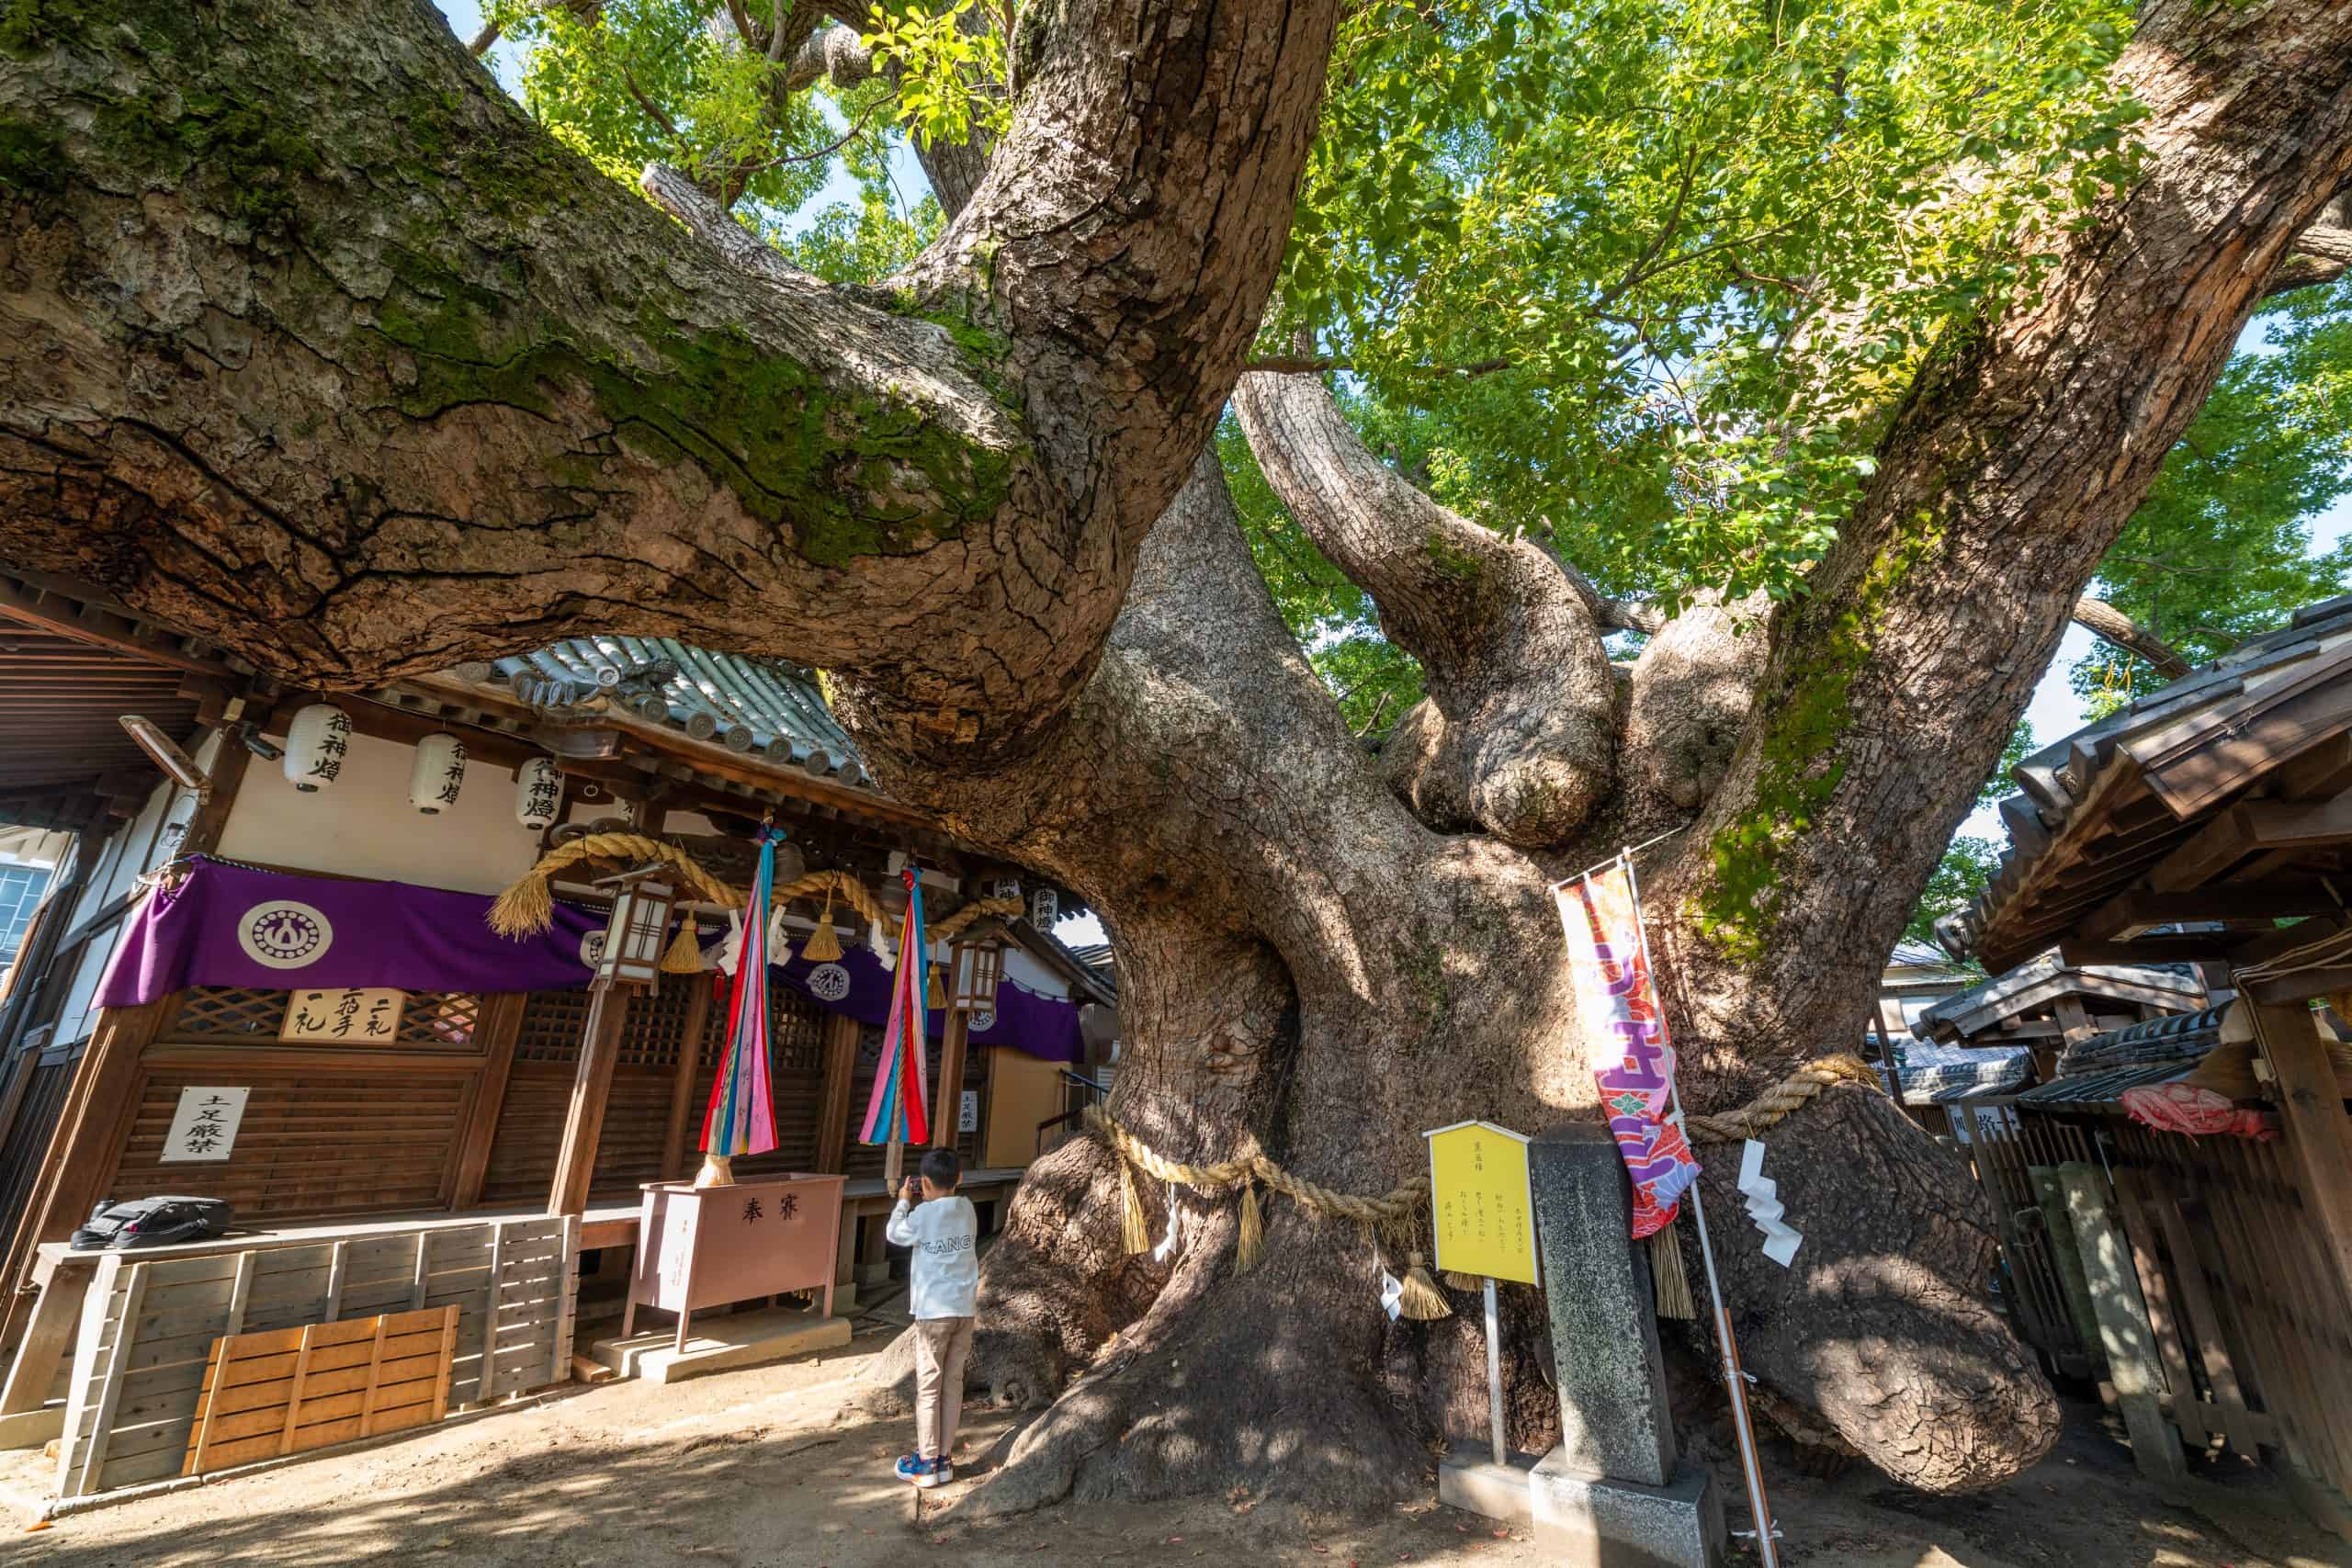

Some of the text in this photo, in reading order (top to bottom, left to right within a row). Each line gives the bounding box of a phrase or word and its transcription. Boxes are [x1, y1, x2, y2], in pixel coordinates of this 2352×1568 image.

[294, 992, 327, 1034] 一礼
[363, 998, 391, 1037] 二礼
[184, 1095, 232, 1154] 土足厳禁
